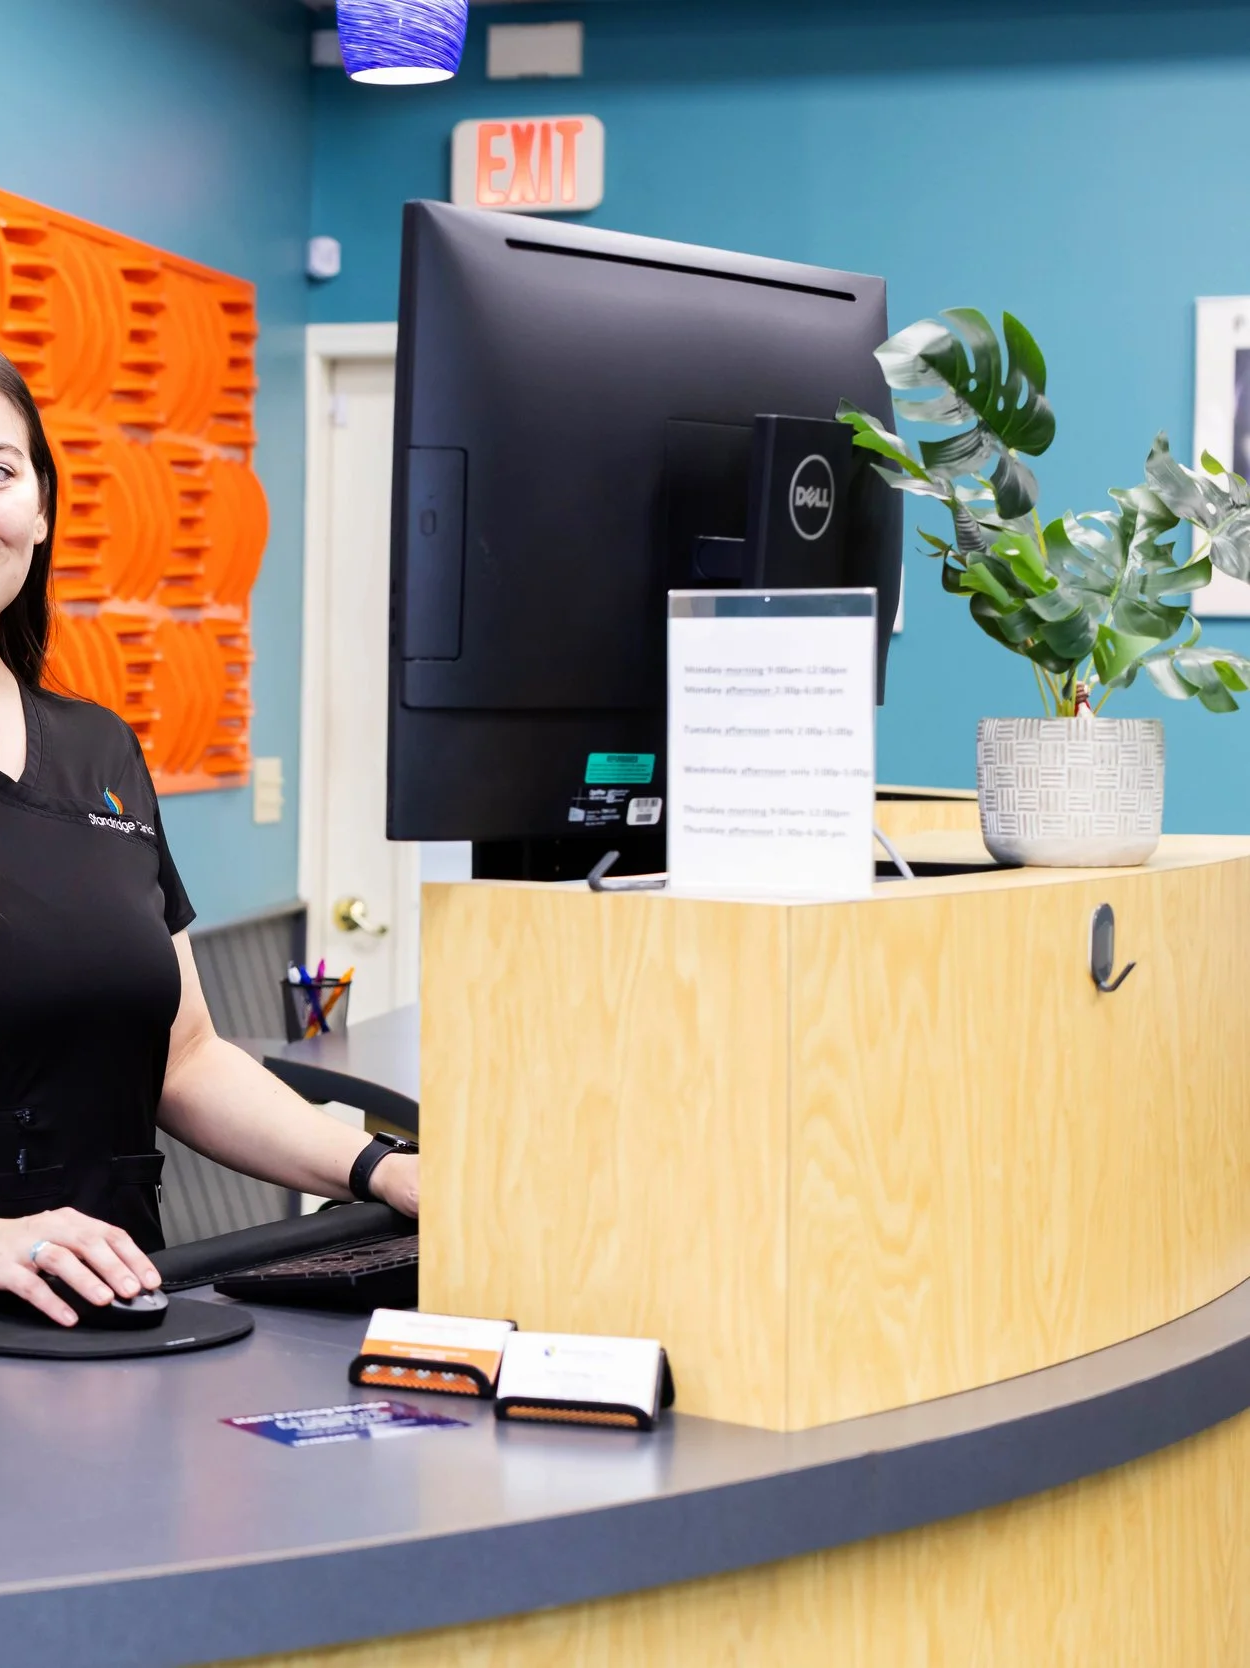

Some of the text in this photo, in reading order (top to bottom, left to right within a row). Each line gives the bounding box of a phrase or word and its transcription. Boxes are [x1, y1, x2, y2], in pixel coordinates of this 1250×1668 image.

[476, 120, 584, 205] EXIT
[794, 486, 830, 508] DELL
[88, 813, 136, 833] Standridge
